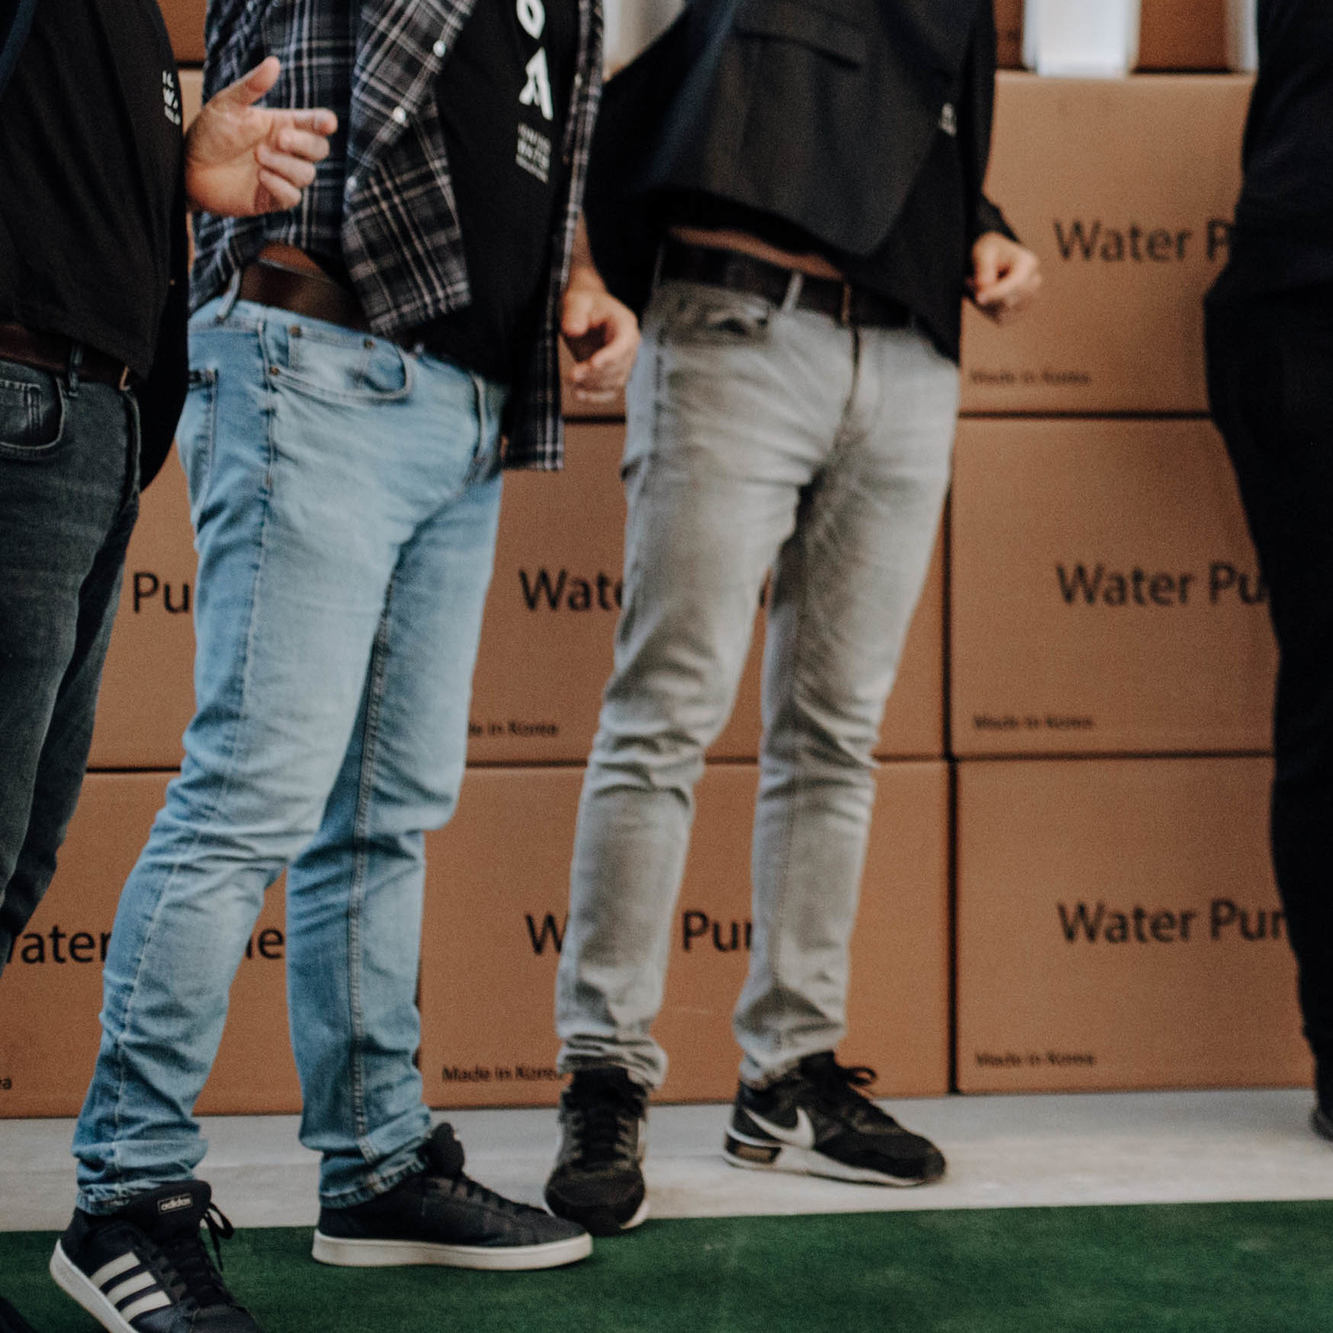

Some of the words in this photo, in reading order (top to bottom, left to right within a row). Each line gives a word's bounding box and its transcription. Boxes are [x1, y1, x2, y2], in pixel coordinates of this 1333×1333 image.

[1055, 220, 1193, 262] Water
[1056, 563, 1196, 607] Water
[1057, 901, 1197, 944] Water
